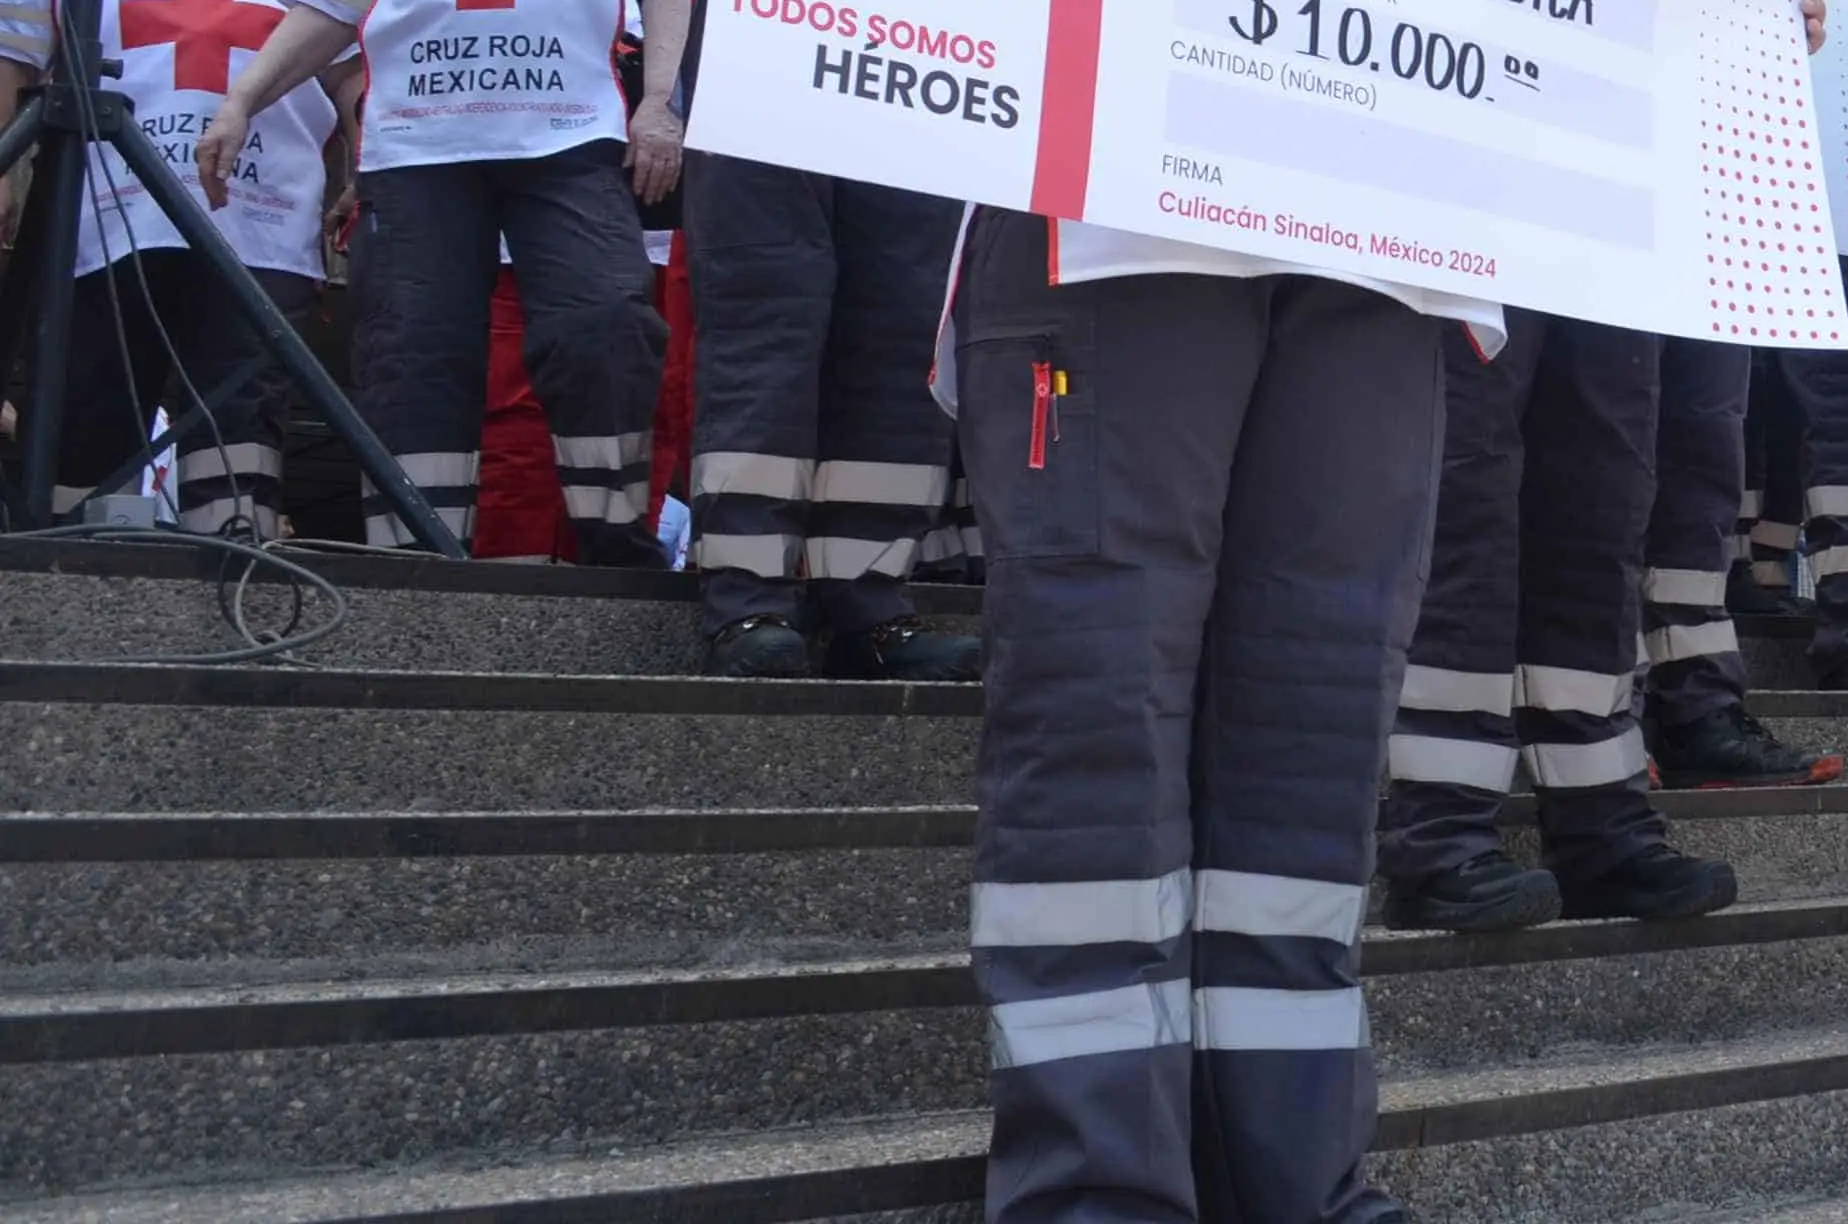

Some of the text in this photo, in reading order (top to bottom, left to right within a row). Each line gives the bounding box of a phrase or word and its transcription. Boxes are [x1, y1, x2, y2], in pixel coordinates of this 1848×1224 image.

[411, 35, 564, 64] CRUZ ROJA
[867, 15, 996, 69] SOMOS
[408, 68, 564, 96] MEXICANA
[813, 41, 1020, 129] HÉROES
[1170, 41, 1377, 111] CANTIDAD (NÚMERO)
[143, 114, 195, 137] RUZ
[1162, 154, 1224, 186] FIRMA
[1159, 191, 1496, 278] Culiacán Sinaloa, México 2024
